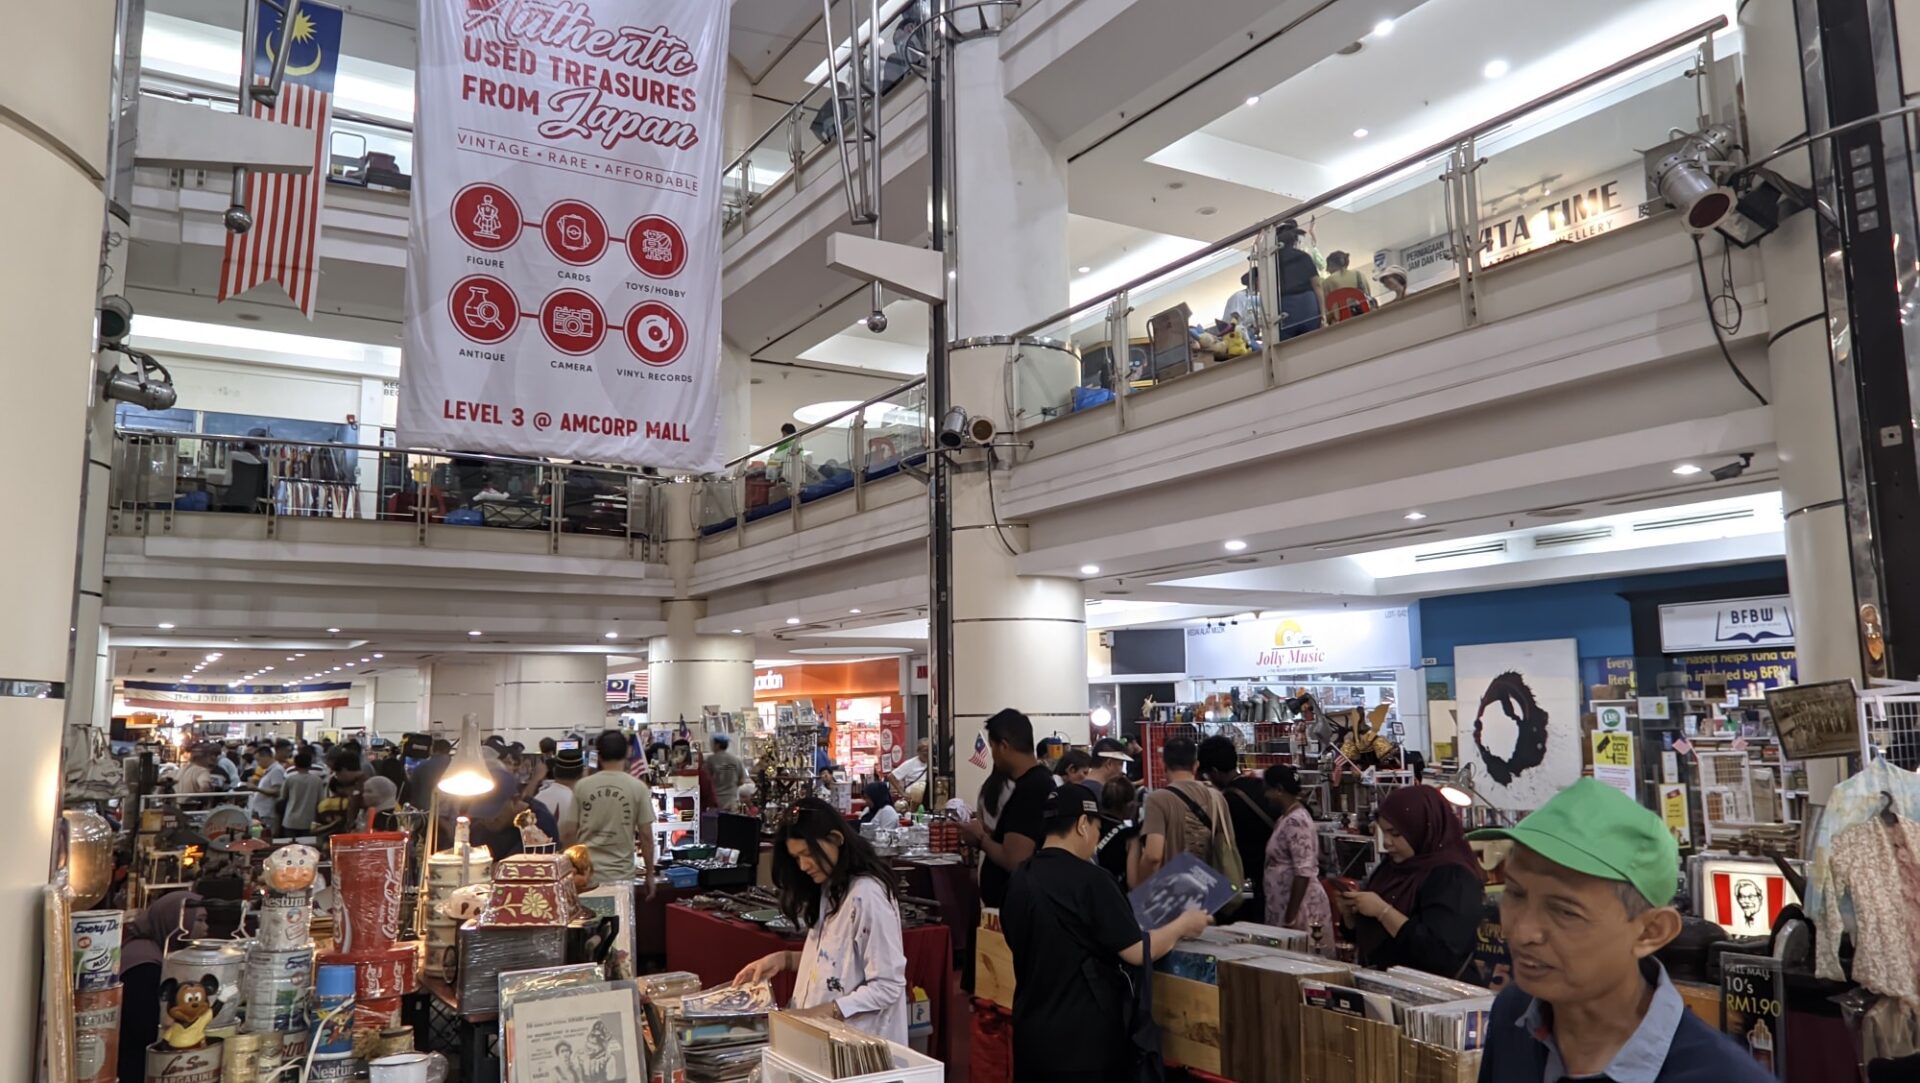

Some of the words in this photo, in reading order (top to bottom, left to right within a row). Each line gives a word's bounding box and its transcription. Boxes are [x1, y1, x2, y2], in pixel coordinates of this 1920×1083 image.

[463, 0, 698, 77] Authentic
[463, 36, 537, 75] USED
[548, 55, 697, 112] TREASURES
[462, 74, 540, 115] FROM
[538, 87, 698, 150] Japan
[457, 133, 530, 158] VINTAGE
[547, 152, 588, 169] RARE
[604, 163, 698, 192] AFFORDABLE
[1541, 180, 1621, 230] TIME
[466, 255, 505, 268] FIGURE
[557, 270, 591, 283] CARDS
[625, 281, 686, 299] TOYS/HOBBY
[458, 348, 506, 363] ANTIQUE
[550, 360, 593, 373] CAMERA
[616, 368, 645, 380] VINYL
[647, 371, 693, 383] RECORDS
[443, 399, 503, 425] LEVEL
[511, 408, 524, 427] 3
[533, 411, 552, 431] @
[560, 413, 638, 438] AMCORP
[646, 420, 691, 443] MALL
[1731, 607, 1773, 624] BFBW
[1256, 651, 1285, 667] Jolly
[1288, 648, 1325, 664] Music
[1606, 657, 1633, 670] Every
[1742, 669, 1757, 681] by
[1725, 976, 1753, 994] 10's
[1726, 993, 1781, 1018] RM1.90
